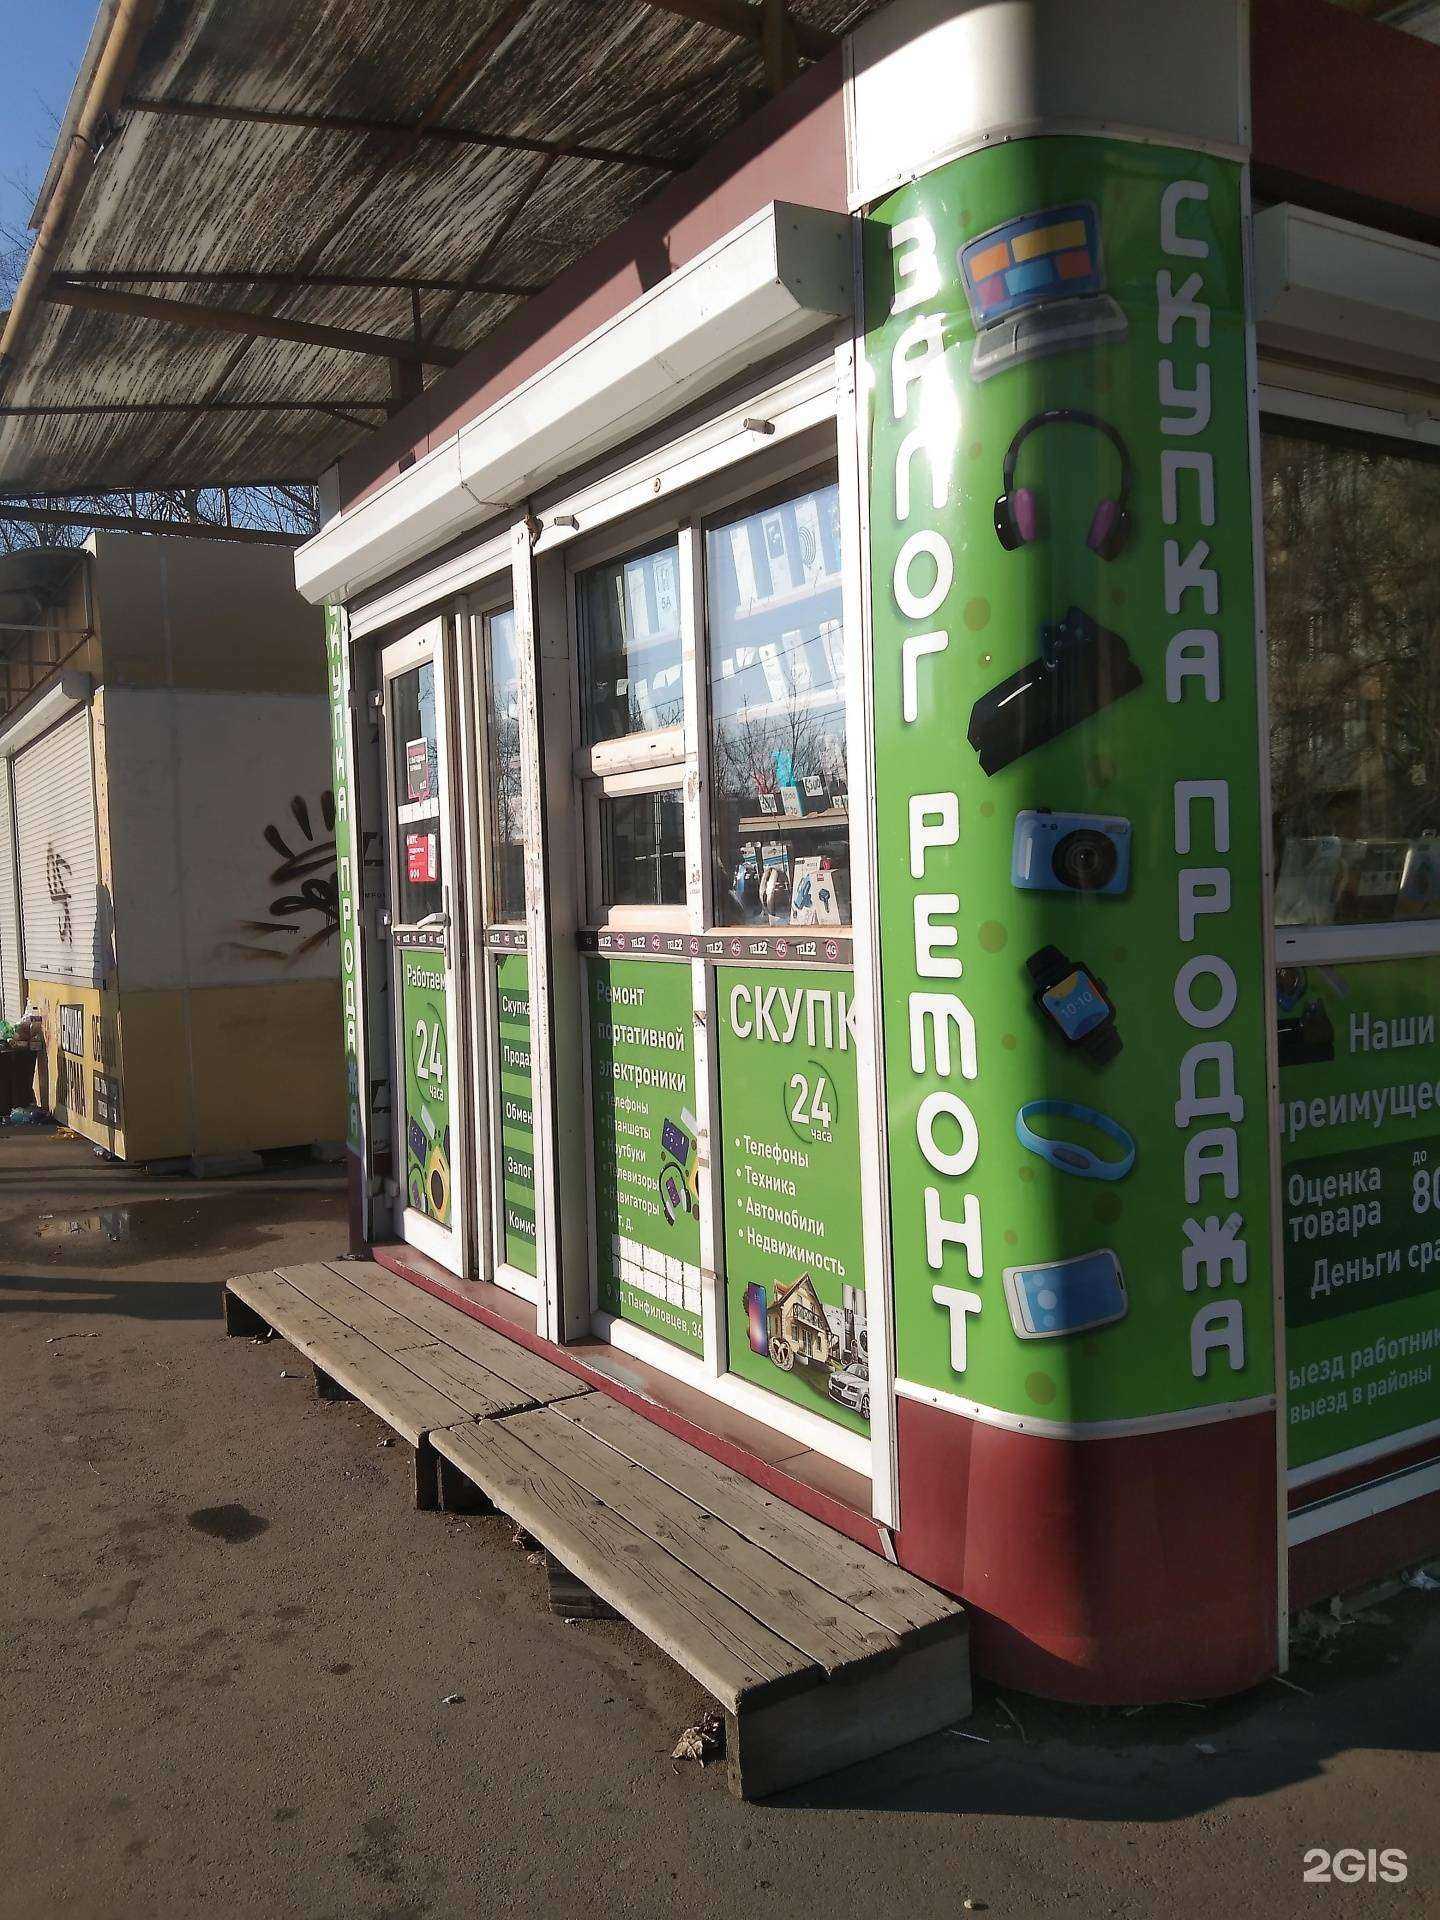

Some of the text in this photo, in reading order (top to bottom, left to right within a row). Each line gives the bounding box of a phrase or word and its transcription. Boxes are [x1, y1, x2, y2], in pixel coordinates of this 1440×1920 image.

[890, 215, 984, 1374] ЗАЛОГ РЕМОНТ
[1157, 180, 1247, 1378] СКУПКА ПРОДАЖА
[630, 936, 646, 948] TELE2
[667, 939, 683, 951] TELE2
[706, 941, 724, 954] TELE2
[749, 941, 768, 955] TELE2
[796, 941, 816, 956] TELE2
[596, 979, 645, 1007] Ремонт
[598, 1021, 685, 1052] портативной
[1349, 1012, 1435, 1053] Наши
[416, 1019, 443, 1084] 24
[600, 1060, 687, 1093] электроники
[429, 1085, 445, 1102] часа
[607, 1091, 649, 1115] Телефоны
[789, 1072, 832, 1128] 24
[506, 1101, 533, 1126] Обмен
[607, 1115, 651, 1140] Планшеты
[608, 1140, 647, 1163] Ноутбуки
[743, 1134, 810, 1169] Телефоны
[810, 1127, 833, 1144] часа
[507, 1156, 533, 1180] Залог
[1412, 1150, 1427, 1167] до
[608, 1162, 659, 1191] Телевизоры
[744, 1166, 797, 1197] Техника
[1288, 1168, 1382, 1208] Оценка
[608, 1185, 660, 1216] Навигаторы
[745, 1196, 826, 1237] Автомобили
[1288, 1200, 1382, 1244] товара
[746, 1226, 846, 1278] Недвижимость
[1310, 1249, 1401, 1300] Деньги
[628, 1292, 691, 1335] Панфиловцев,
[1290, 1363, 1432, 1425] выезд в районы
